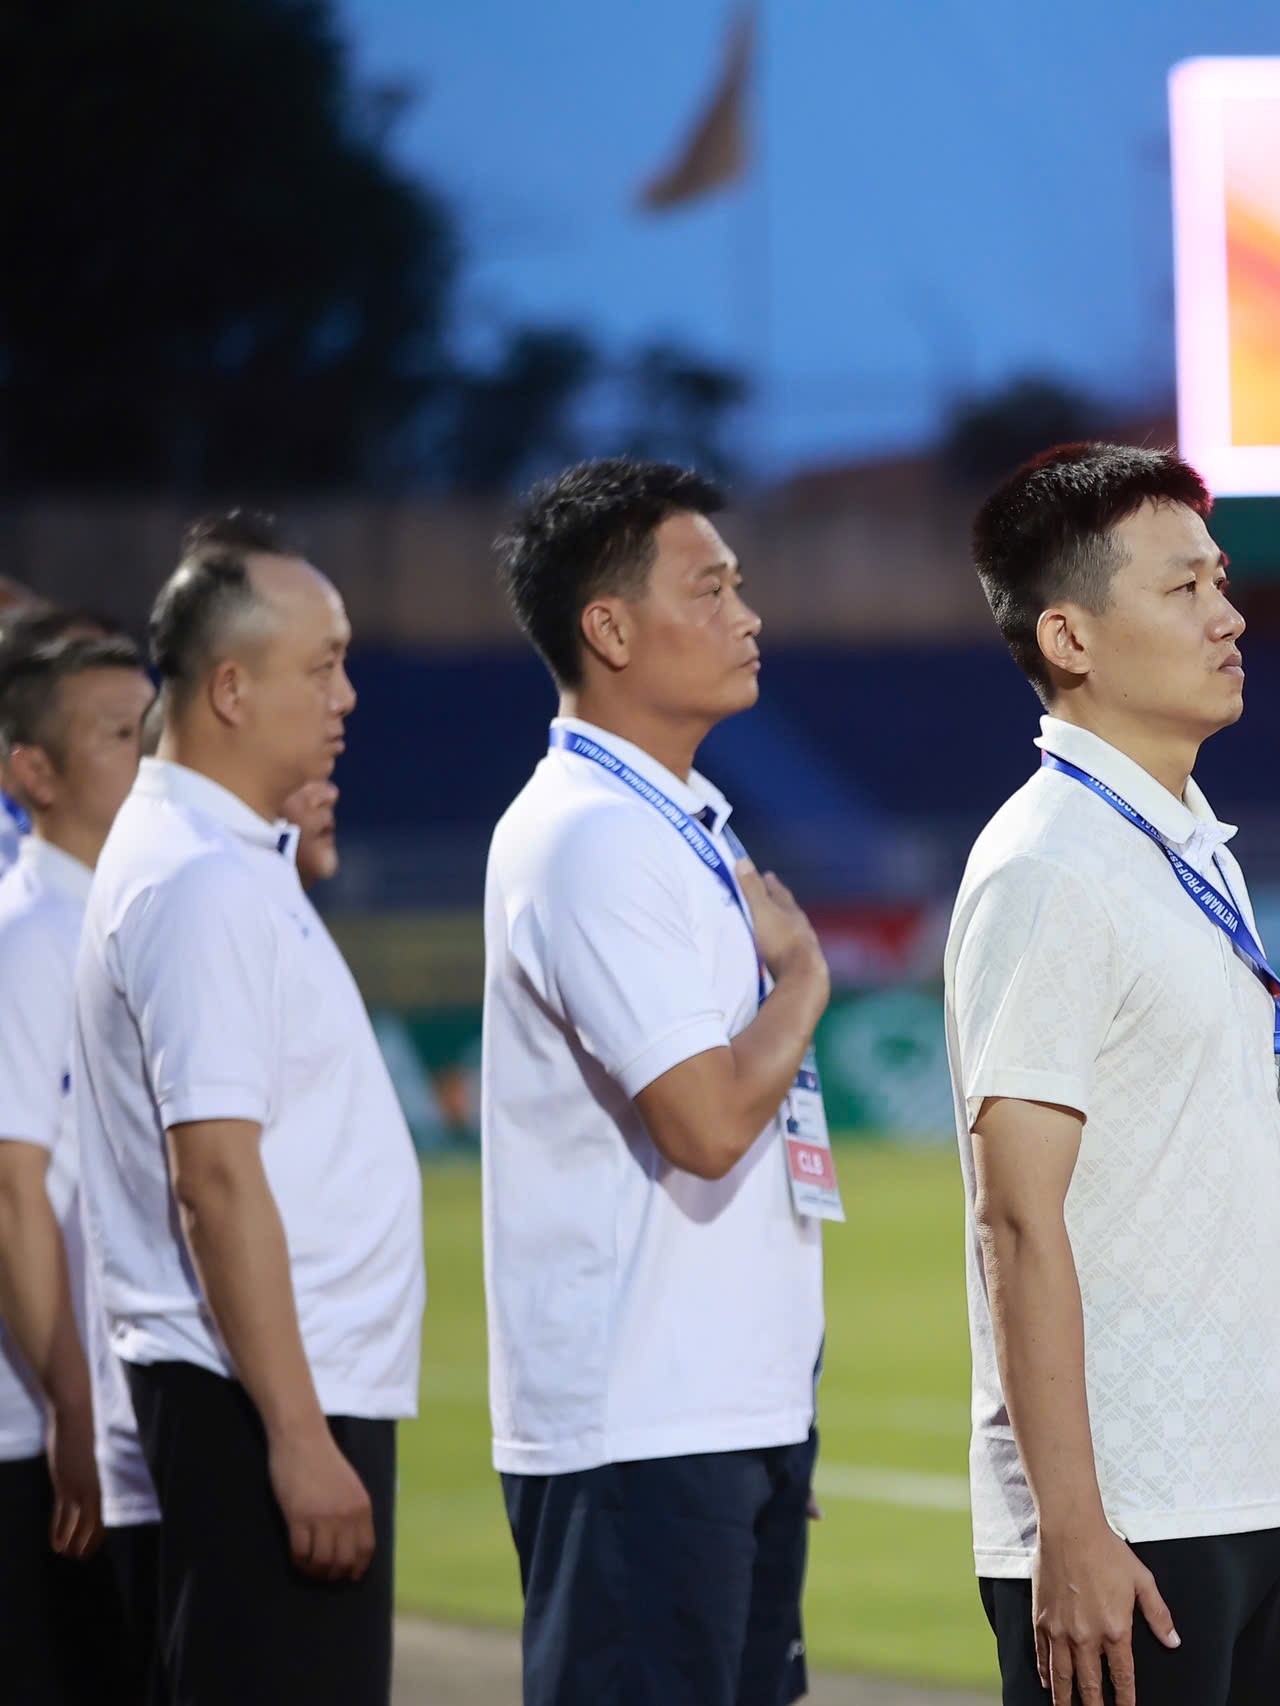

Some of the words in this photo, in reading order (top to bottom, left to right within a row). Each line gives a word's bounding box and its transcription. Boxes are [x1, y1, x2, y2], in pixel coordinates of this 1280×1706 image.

[574, 738, 622, 773] FOOTBALL
[683, 825, 721, 869] VIETNAM
[1200, 891, 1239, 933] VIETNAM
[797, 1150, 824, 1176] CLB
